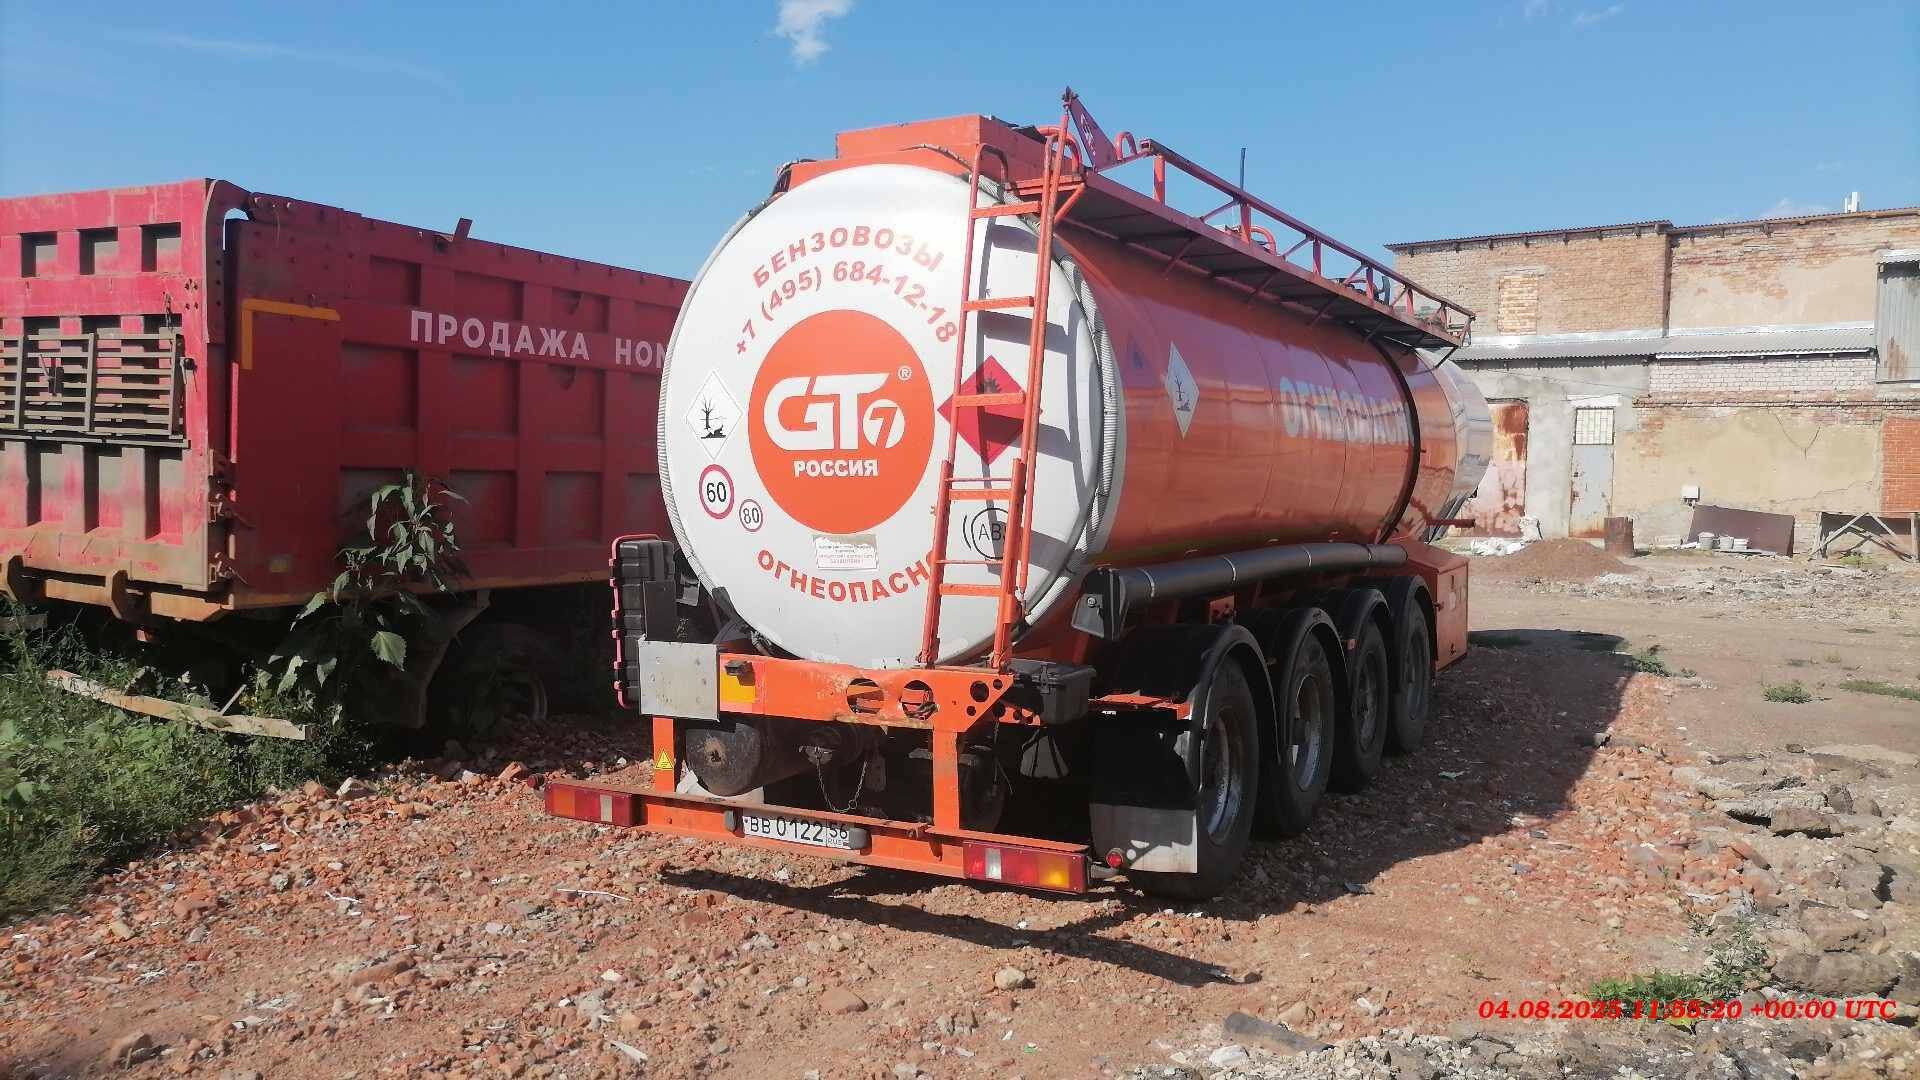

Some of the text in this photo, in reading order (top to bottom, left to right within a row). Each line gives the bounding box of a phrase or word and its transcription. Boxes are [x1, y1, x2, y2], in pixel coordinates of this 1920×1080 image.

[753, 225, 945, 288] БЕНЗОВОЗЫ
[737, 260, 958, 354] +7 (495) 684-12-18
[410, 310, 590, 360] ПРОДАЖА
[793, 459, 879, 477] РОССИЯ
[706, 481, 727, 503] 60
[743, 507, 760, 524] 80
[978, 523, 1007, 541] AB
[757, 549, 936, 603] ОГНЕОПАСН
